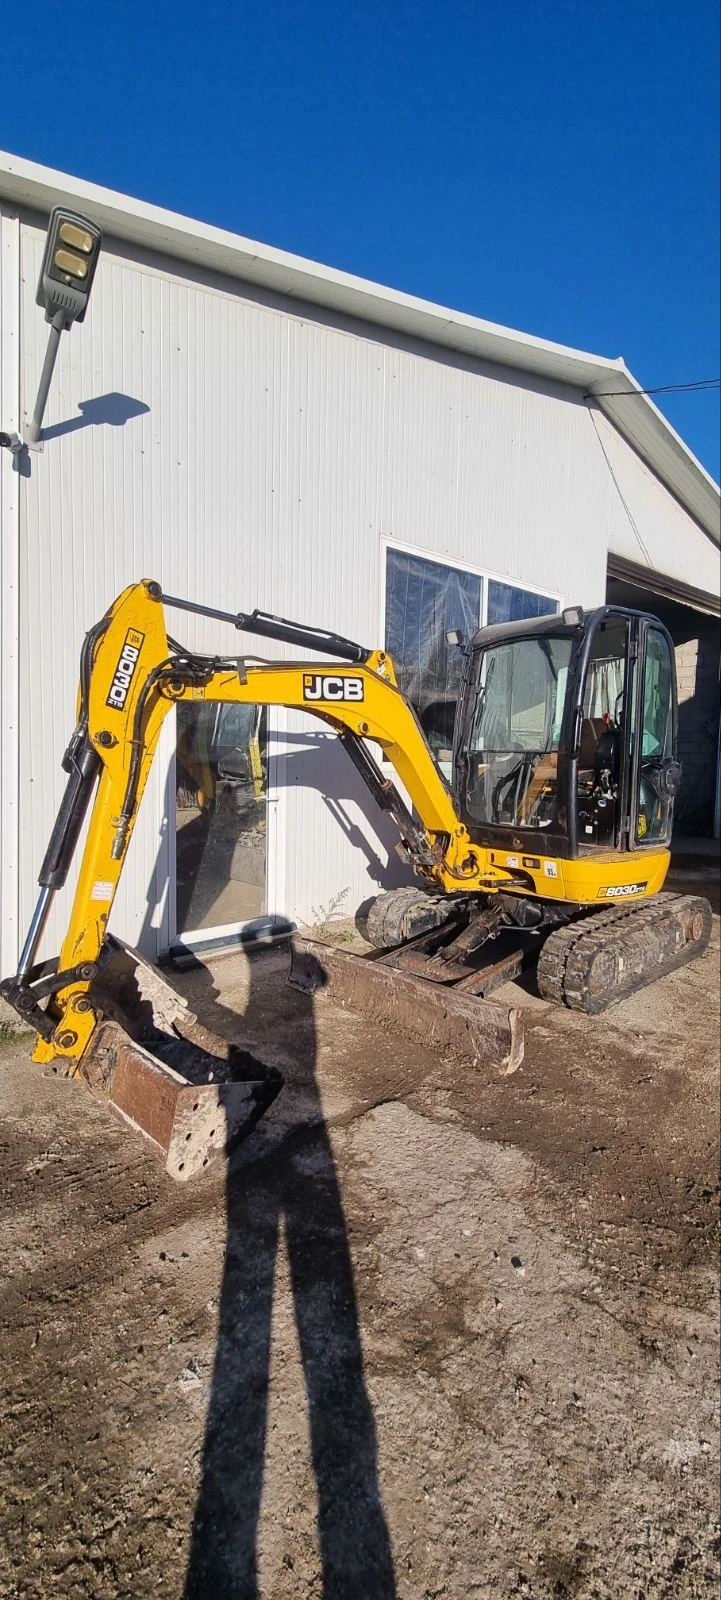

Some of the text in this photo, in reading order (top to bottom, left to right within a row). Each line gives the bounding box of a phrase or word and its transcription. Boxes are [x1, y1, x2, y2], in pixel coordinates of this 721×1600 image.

[110, 644, 139, 702] 8030
[304, 676, 364, 700] JCB
[605, 884, 637, 897] 8030
